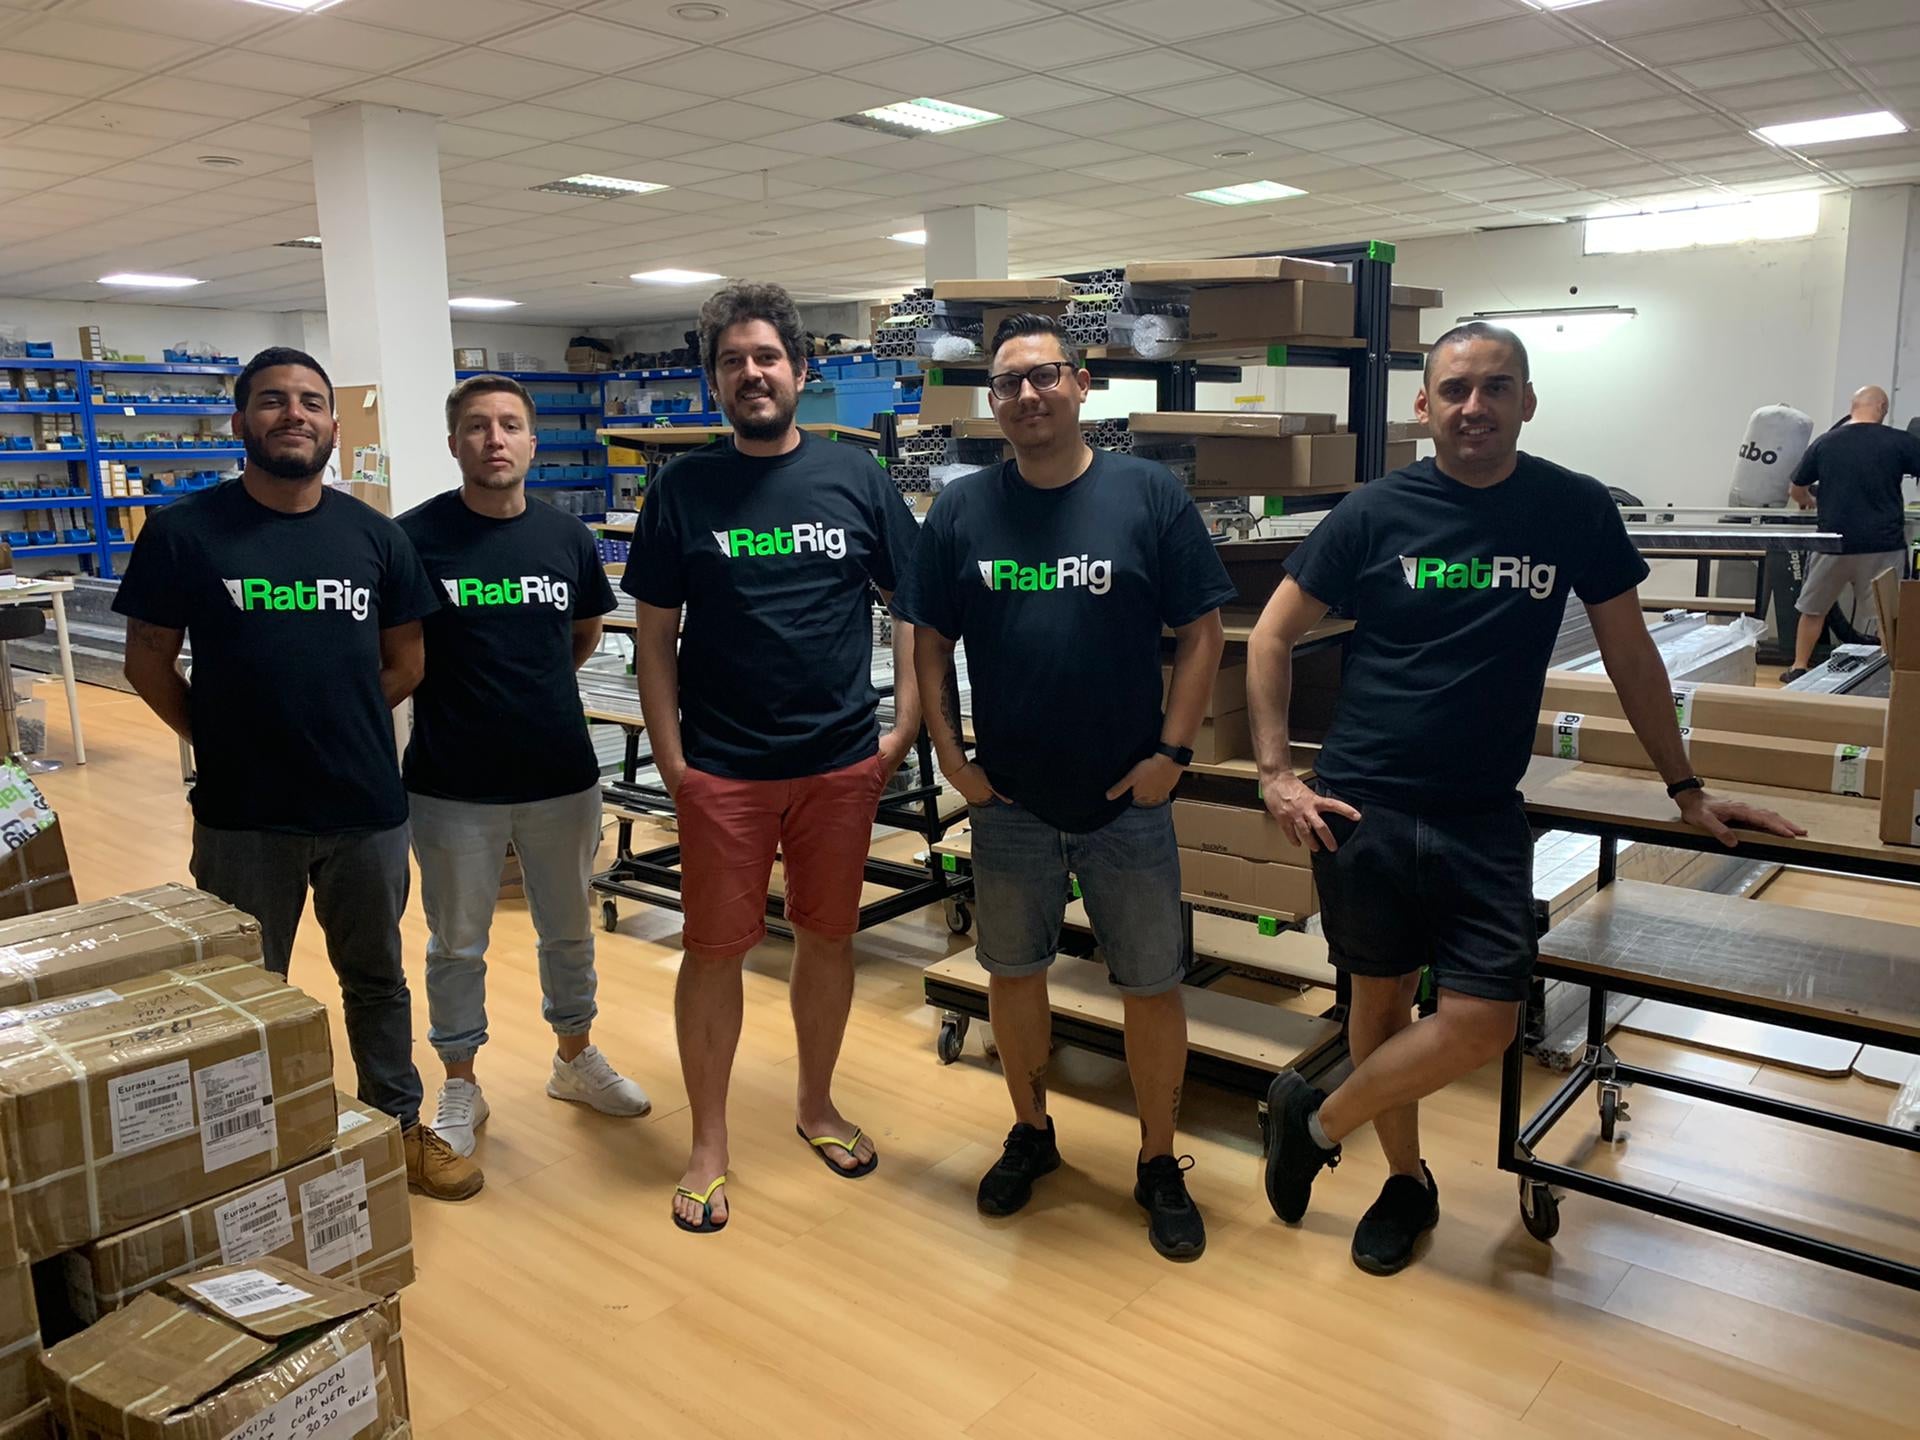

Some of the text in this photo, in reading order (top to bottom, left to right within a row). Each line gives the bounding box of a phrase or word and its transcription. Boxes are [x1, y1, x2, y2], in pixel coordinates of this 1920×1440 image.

[728, 521, 848, 560] RatRig
[458, 575, 570, 612] RatRig
[992, 553, 1113, 596] RatRig
[1416, 555, 1558, 600] RatRig
[243, 577, 371, 622] RatRig
[117, 1078, 157, 1095] Eurasia
[223, 1200, 257, 1221] Eurasia
